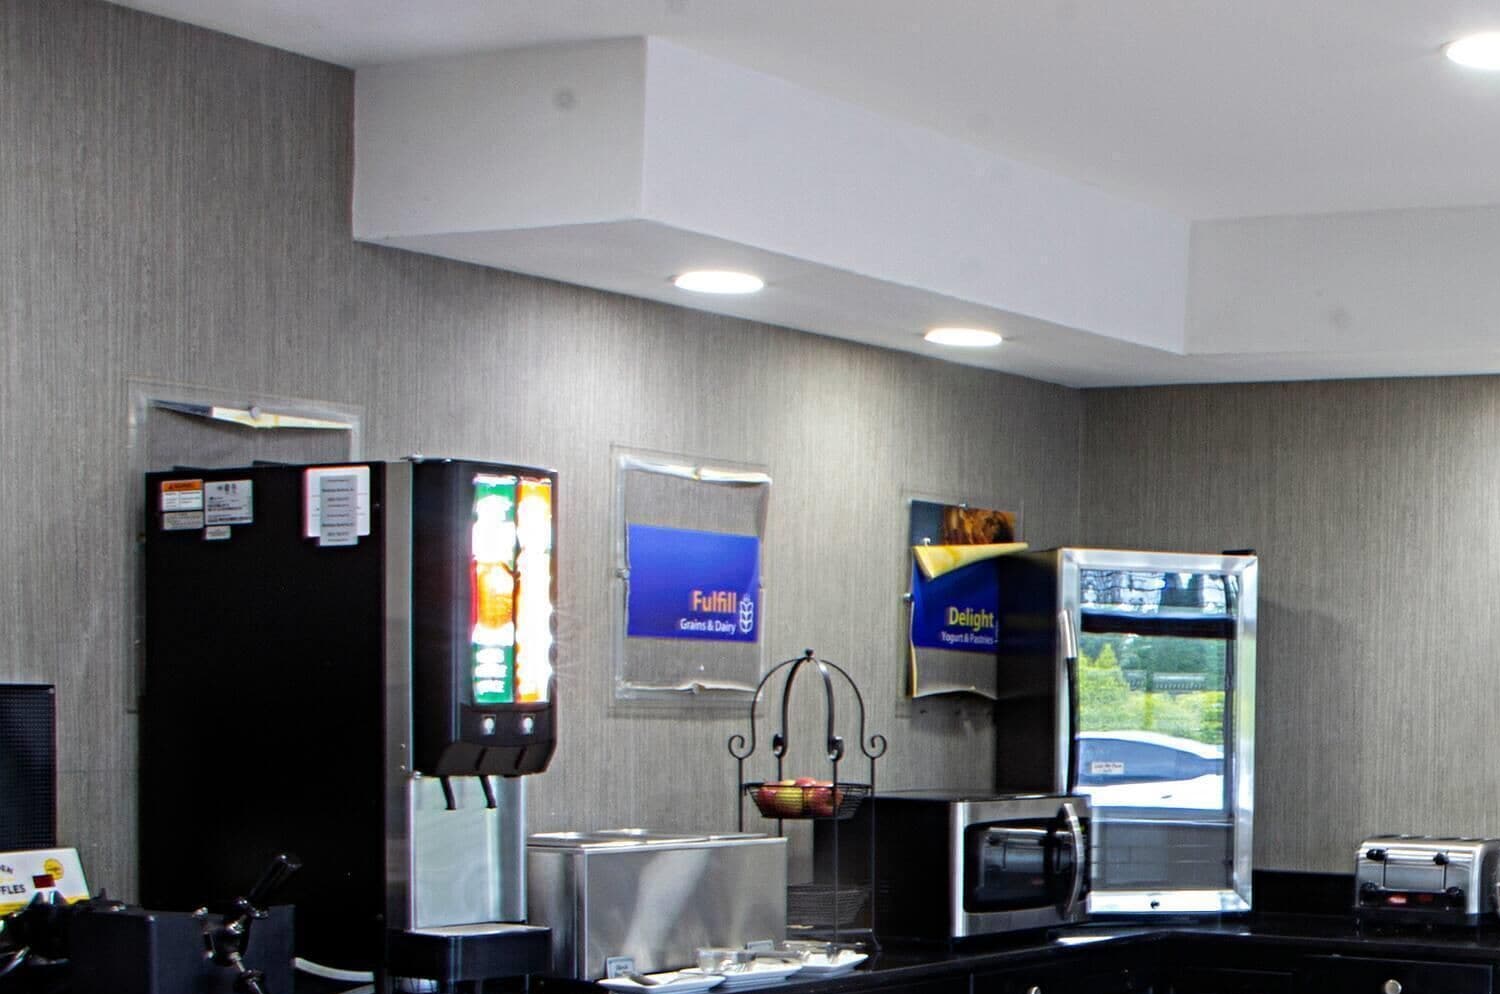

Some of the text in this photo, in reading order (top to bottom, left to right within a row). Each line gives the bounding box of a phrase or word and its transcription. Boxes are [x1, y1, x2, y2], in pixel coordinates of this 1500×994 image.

[692, 589, 736, 613] Fulfill
[680, 618, 737, 635] Grains & Dairy
[948, 606, 994, 632] Delight
[941, 631, 963, 644] Yogurt
[963, 633, 969, 643] &
